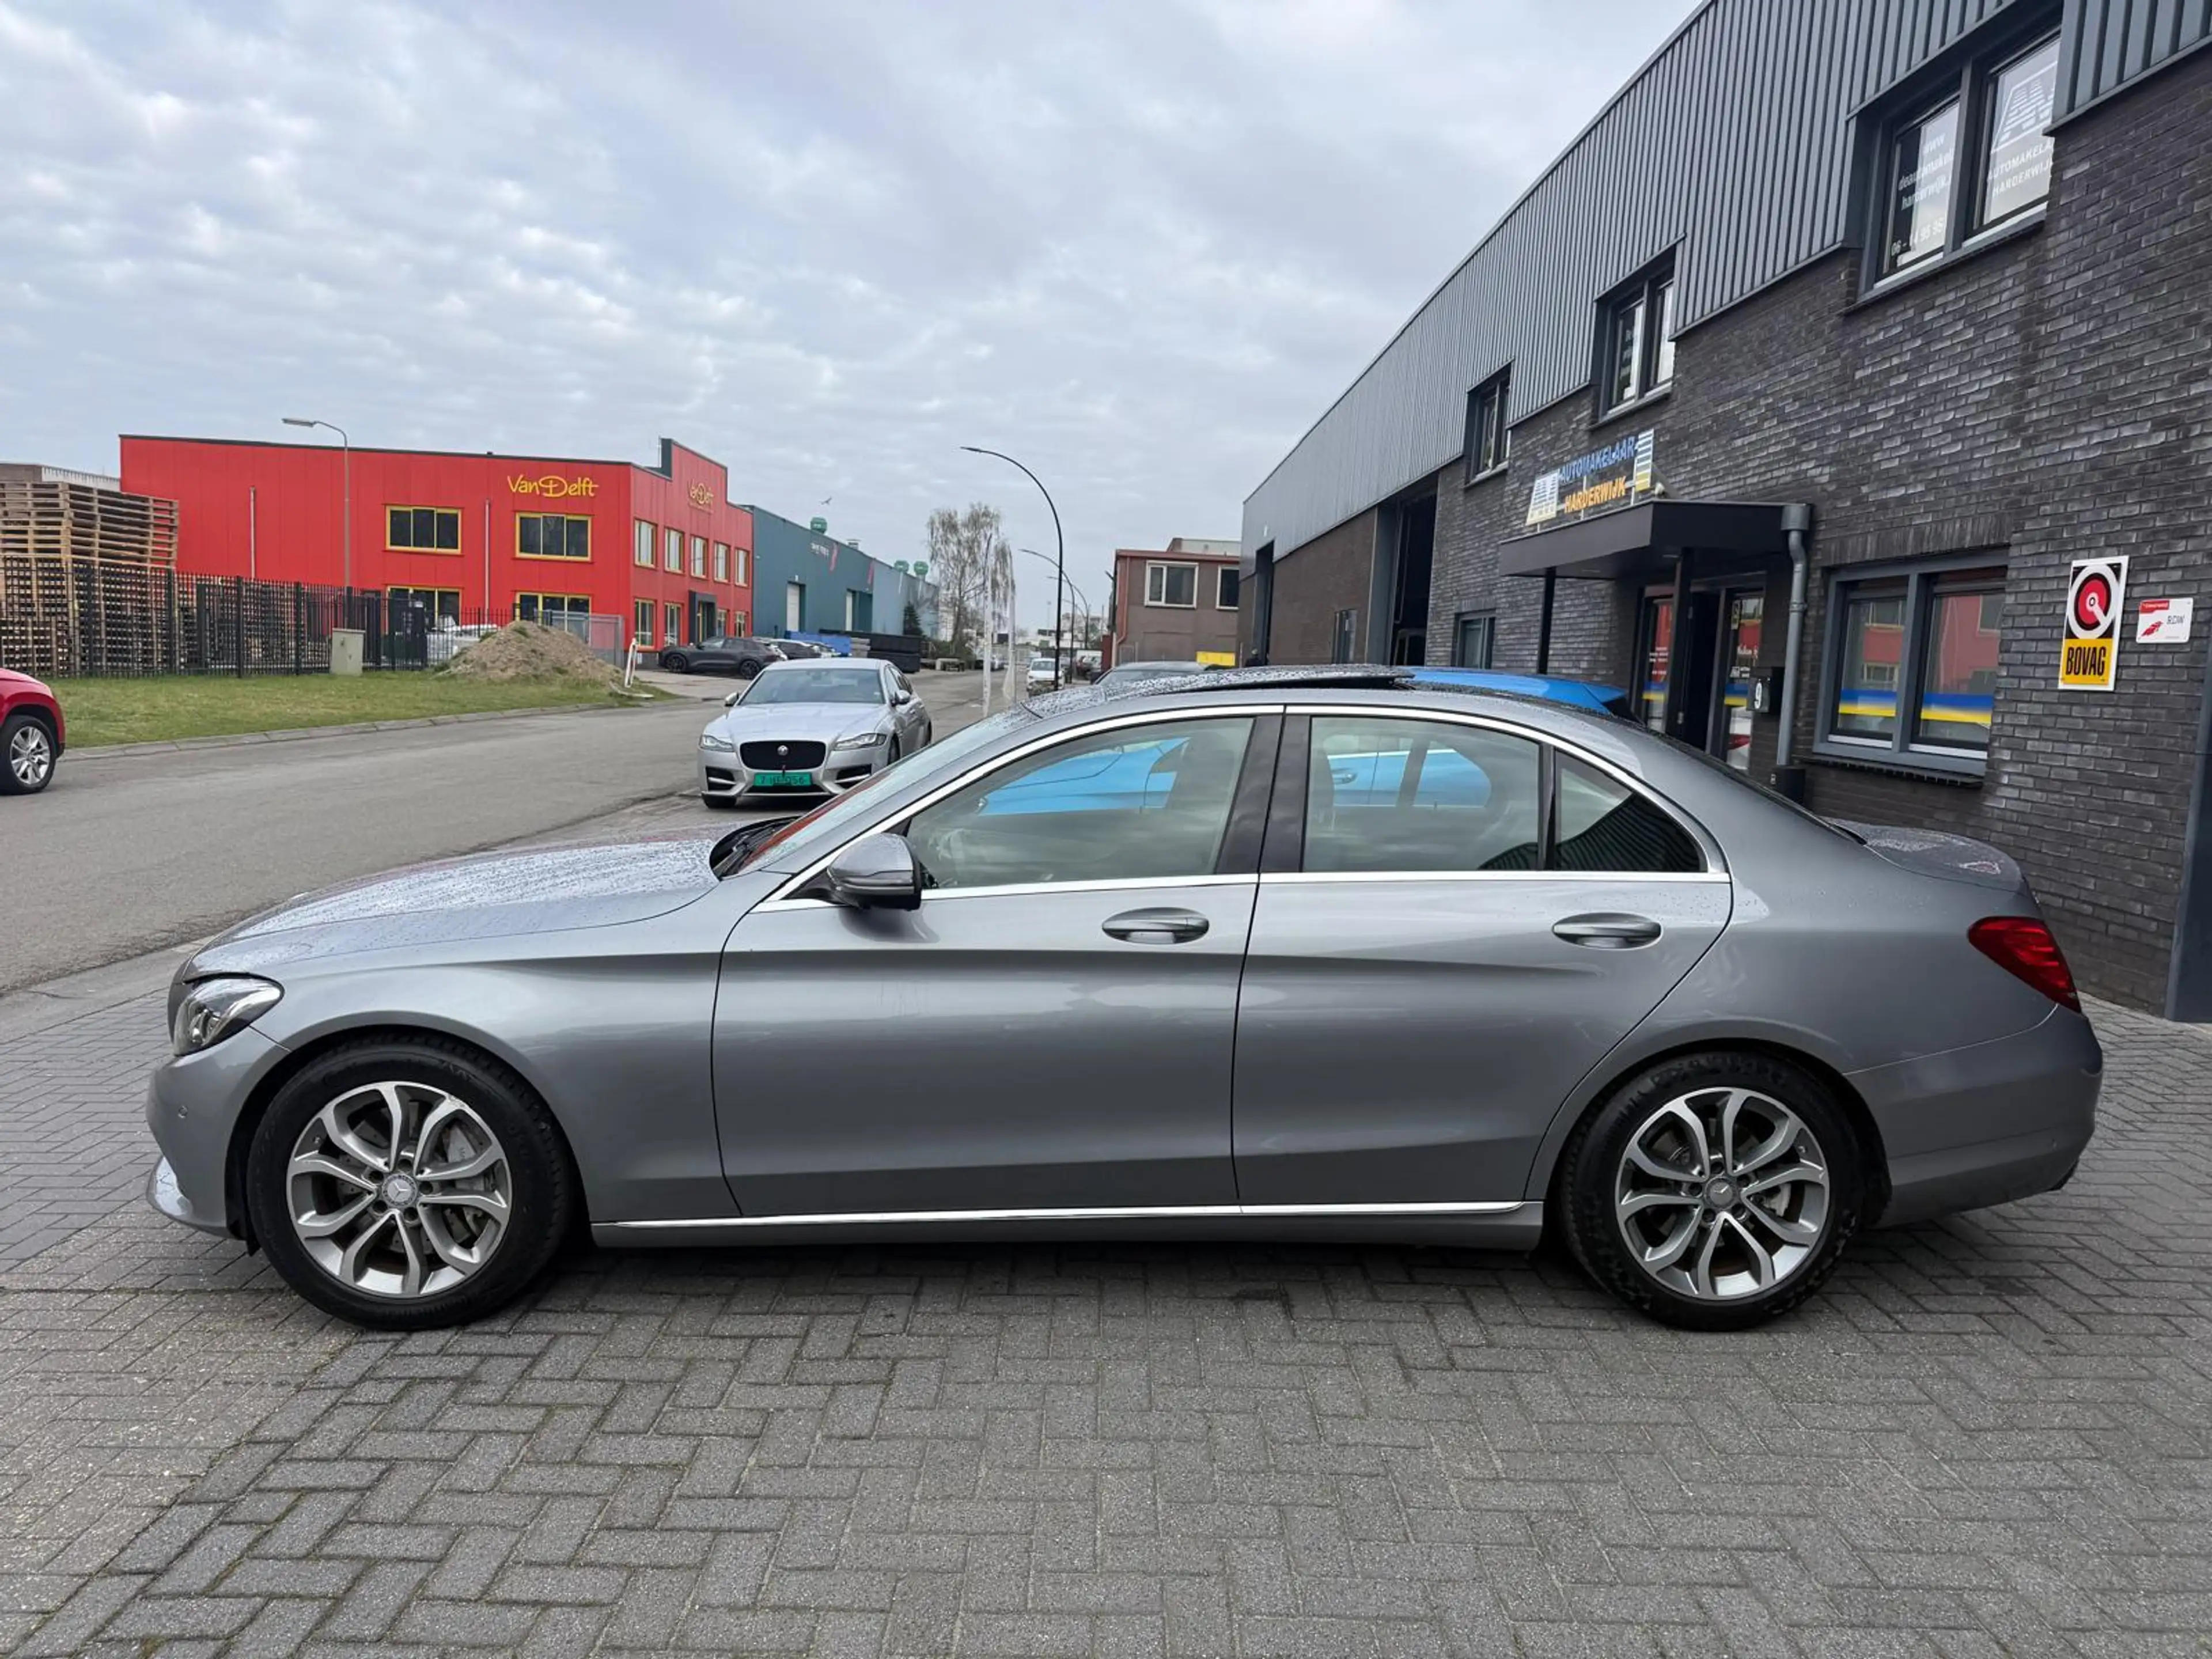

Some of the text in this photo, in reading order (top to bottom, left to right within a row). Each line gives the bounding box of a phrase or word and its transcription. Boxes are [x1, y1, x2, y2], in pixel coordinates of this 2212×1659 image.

[507, 474, 600, 498] Van Delft
[1564, 476, 1626, 513] HARDERWIJK
[2065, 646, 2107, 676] BOVAG
[1754, 682, 1763, 709] 9
